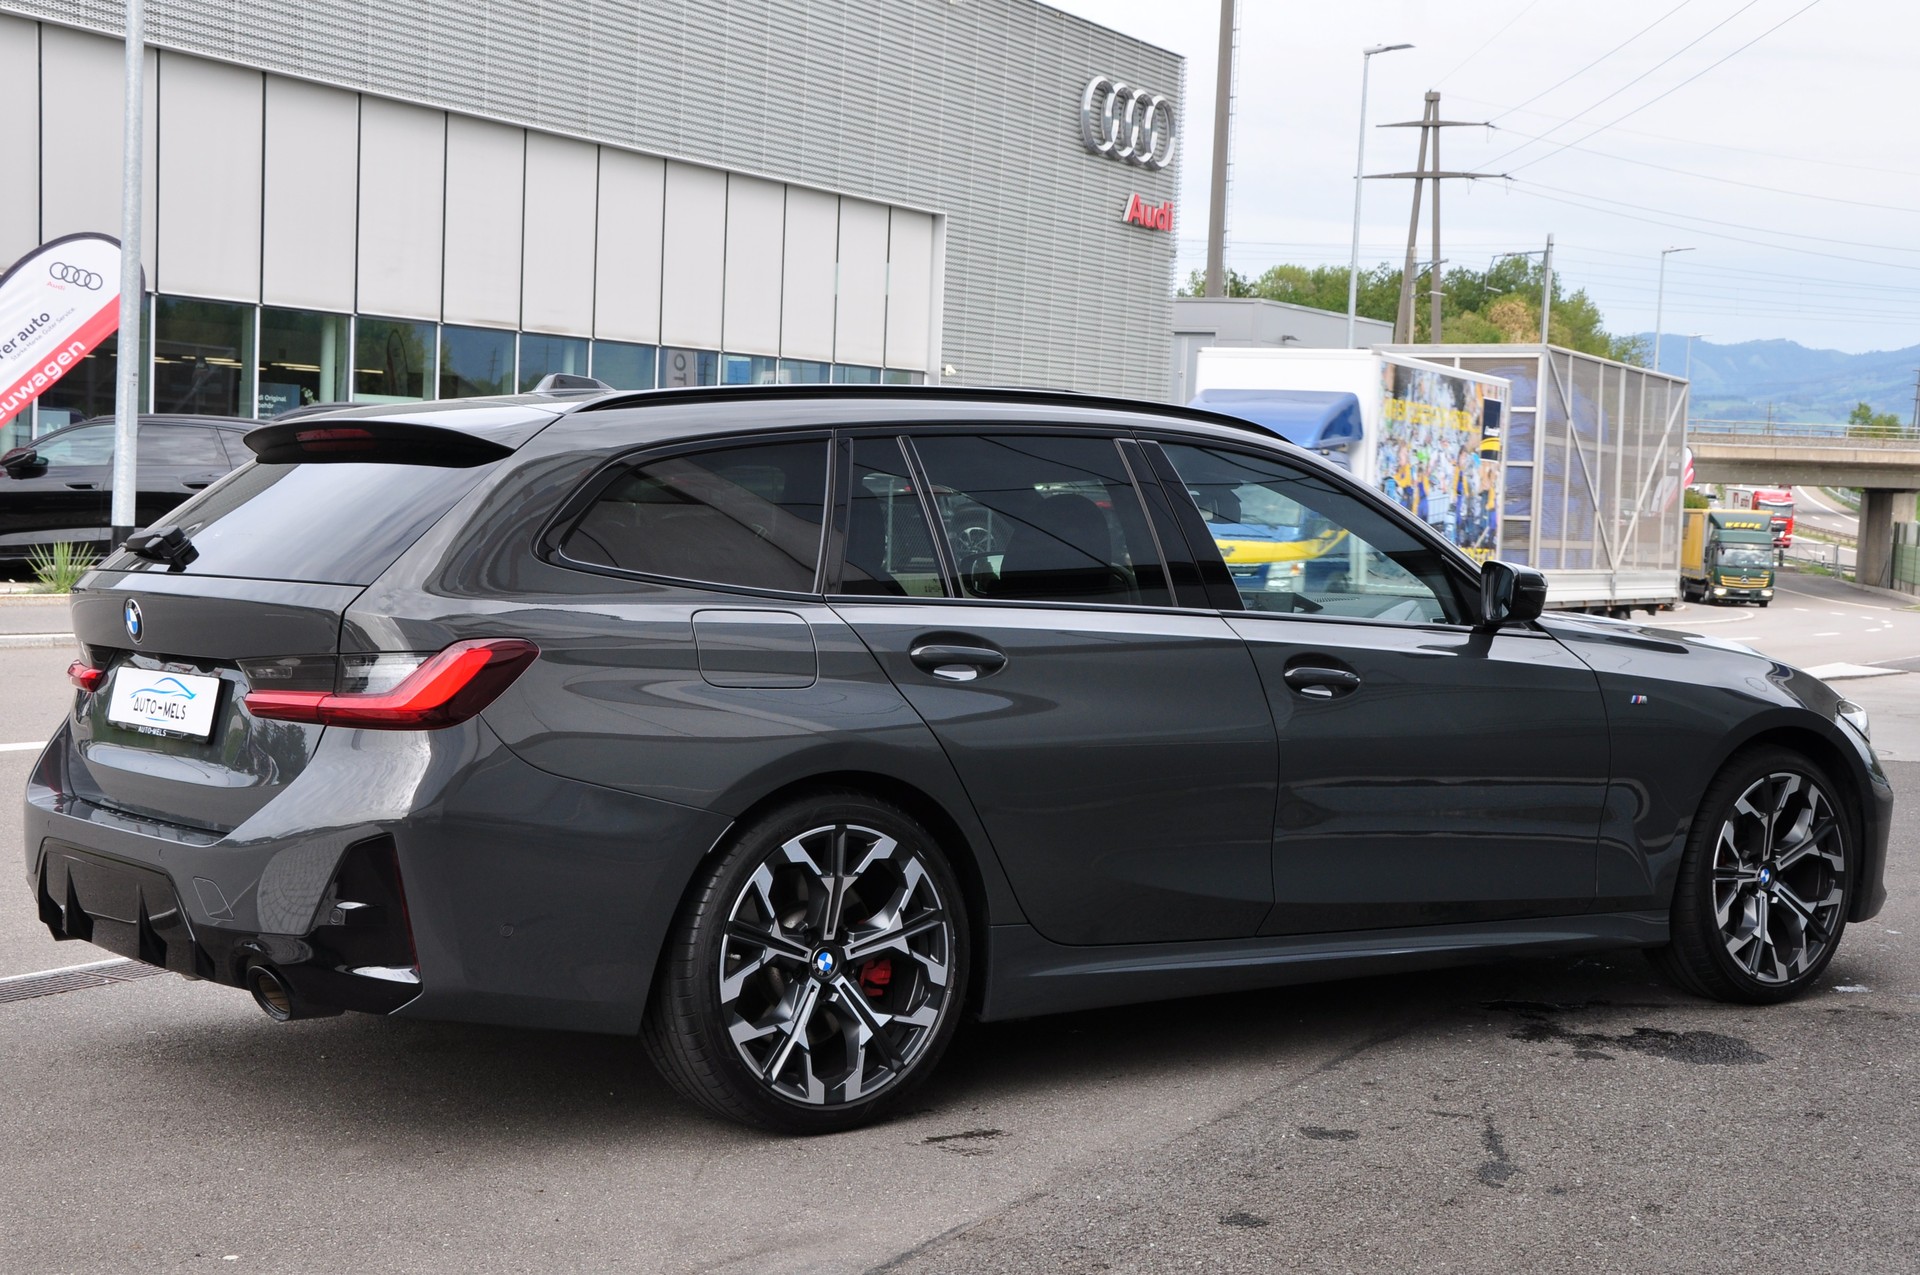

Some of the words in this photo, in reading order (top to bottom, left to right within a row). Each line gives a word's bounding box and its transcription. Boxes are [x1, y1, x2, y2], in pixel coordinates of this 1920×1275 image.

[1124, 192, 1174, 232] Audi
[17, 312, 50, 342] auto
[264, 394, 287, 402] Original
[138, 725, 167, 737] AUTO-MELS
